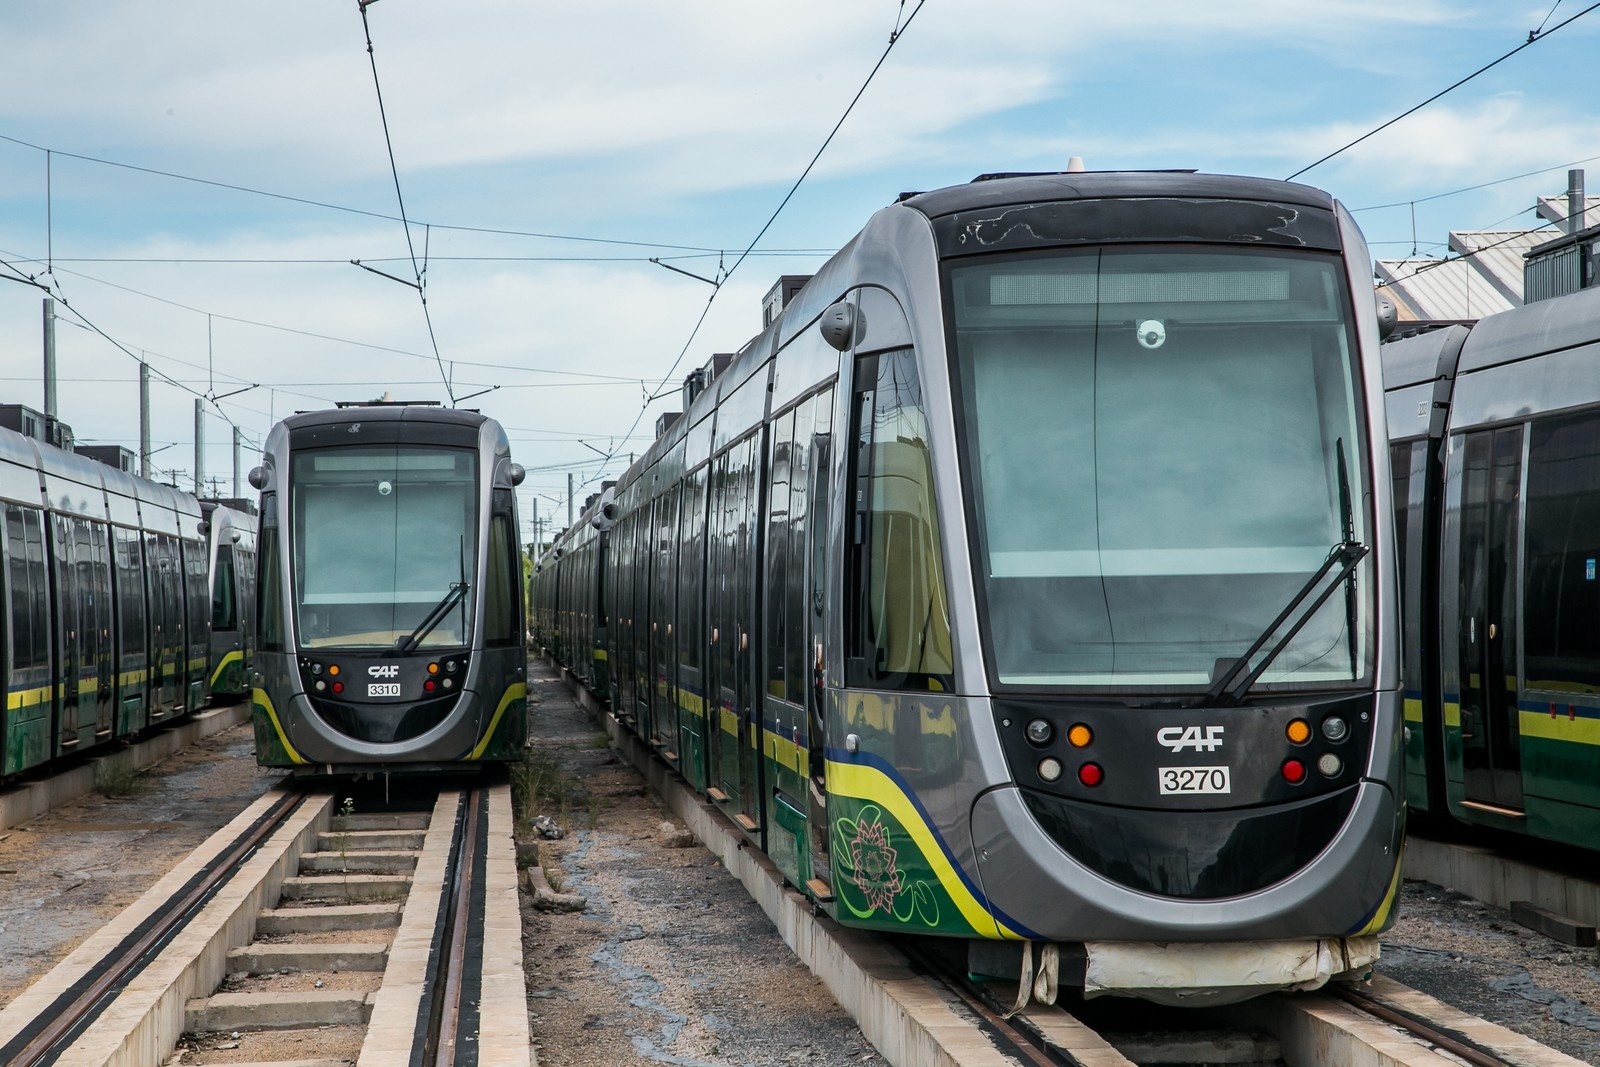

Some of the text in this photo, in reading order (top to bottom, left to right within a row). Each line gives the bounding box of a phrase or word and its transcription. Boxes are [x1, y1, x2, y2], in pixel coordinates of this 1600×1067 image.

[368, 665, 399, 678] CAF
[370, 685, 399, 695] 3310
[1157, 726, 1224, 752] CAF
[1164, 769, 1226, 791] 3270
